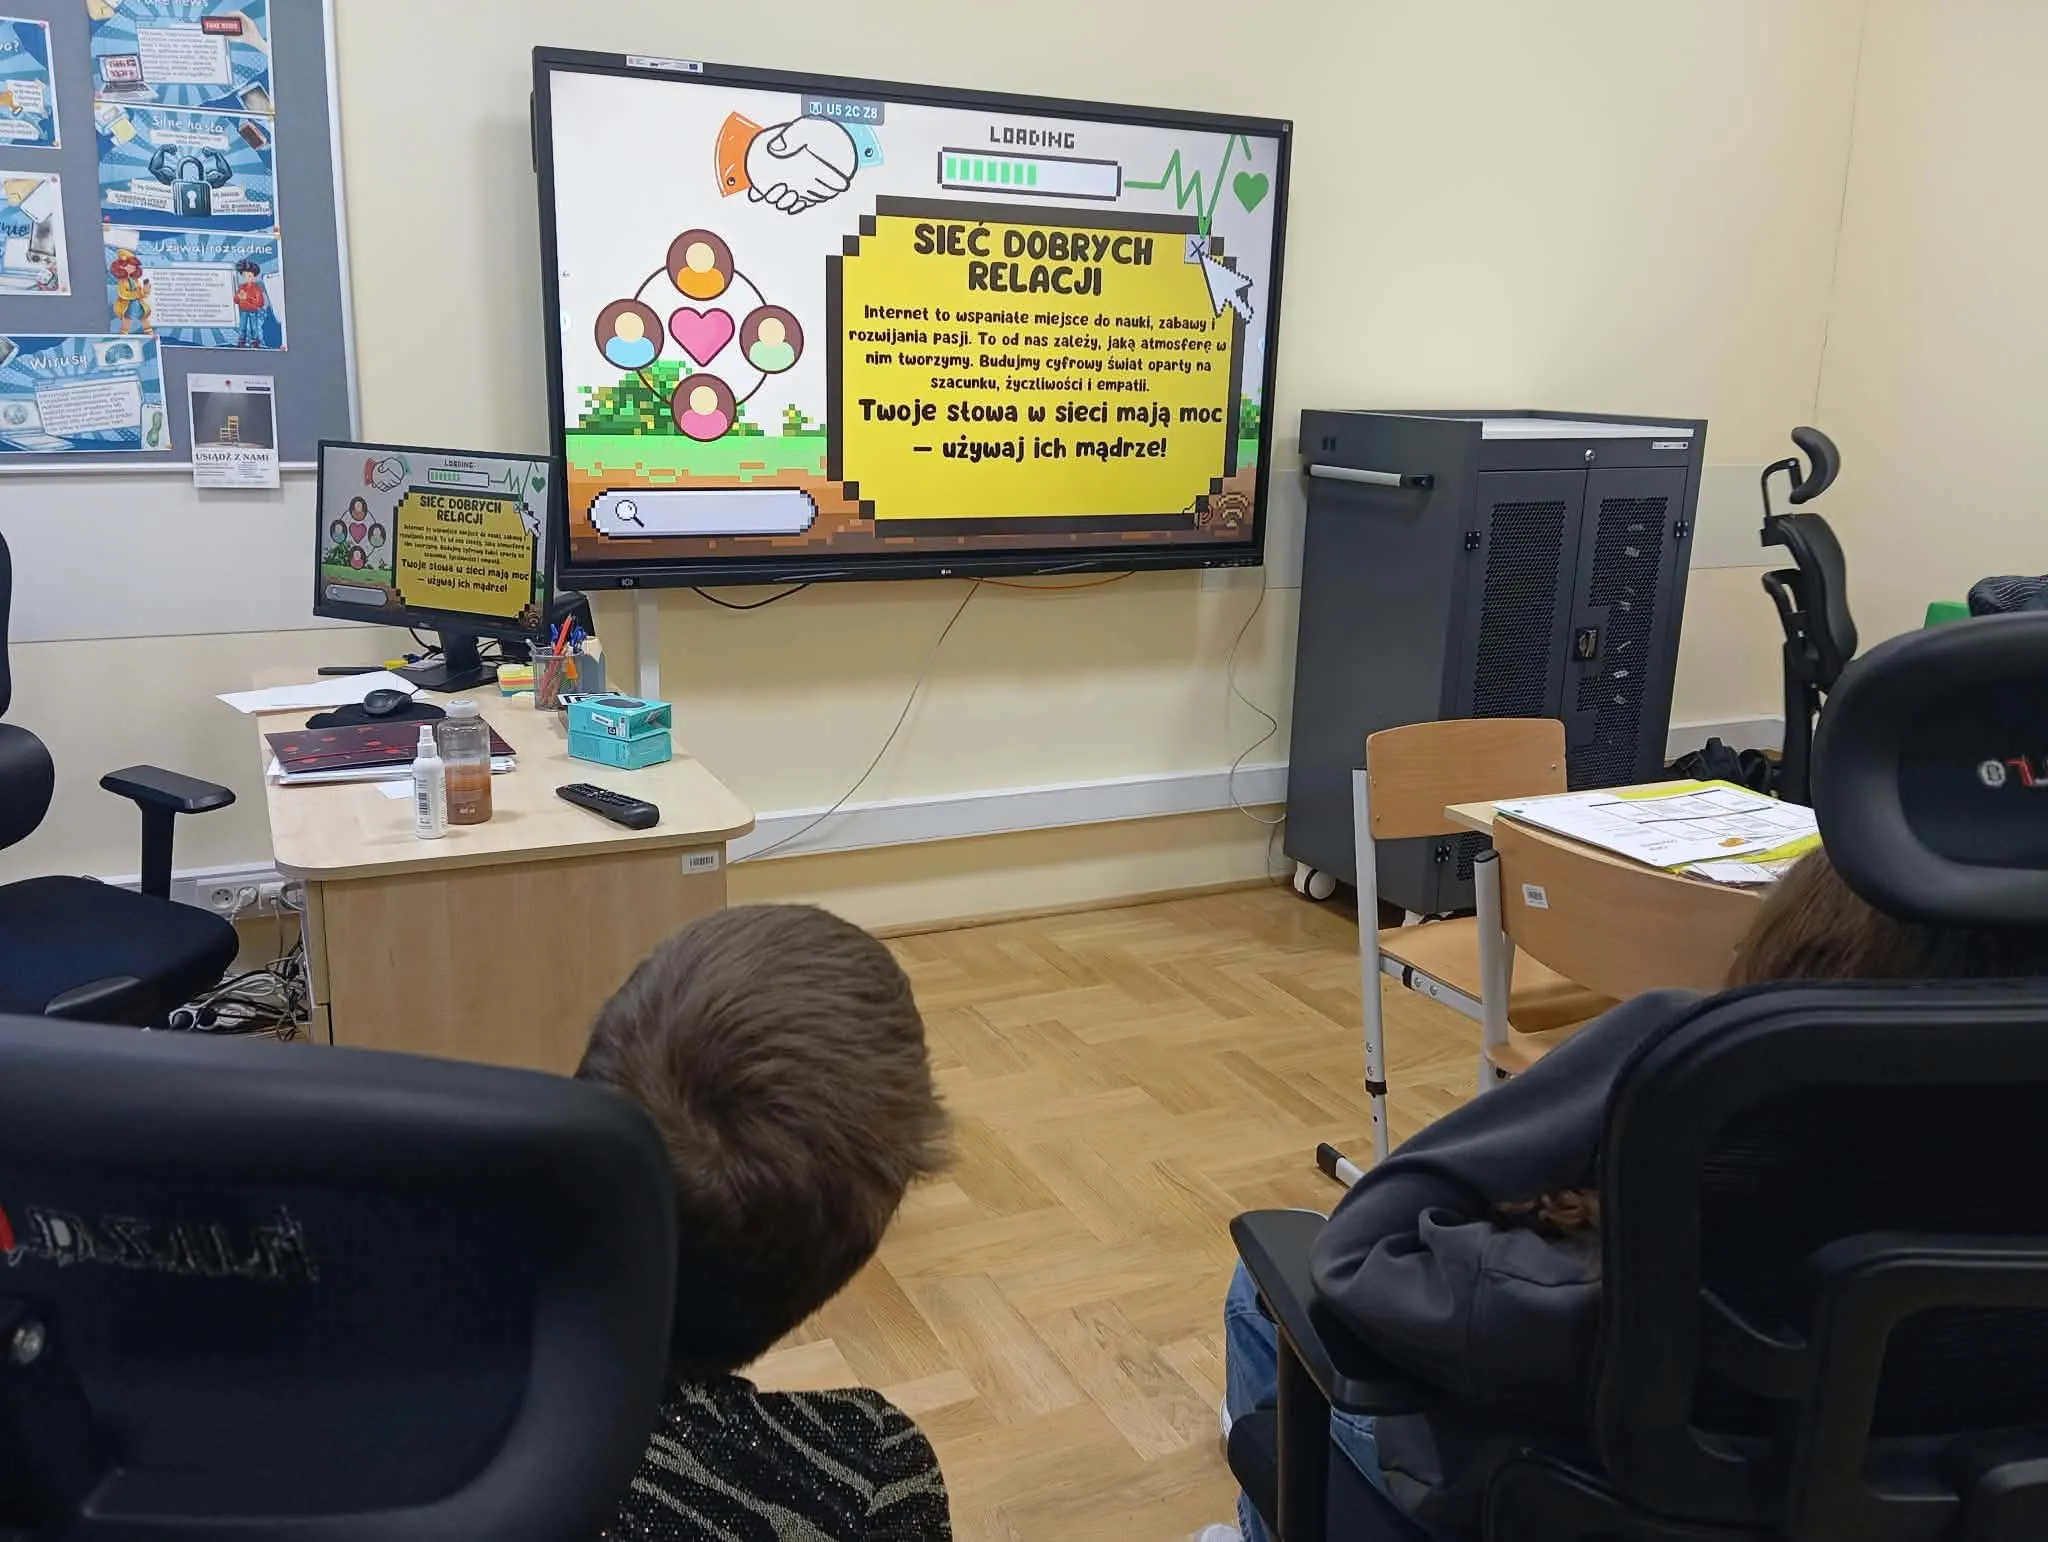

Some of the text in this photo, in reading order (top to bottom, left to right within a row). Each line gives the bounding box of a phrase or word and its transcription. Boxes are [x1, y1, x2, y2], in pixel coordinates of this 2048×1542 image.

[827, 103, 878, 119] U5 2C Z8
[990, 125, 1075, 150] LOADING
[913, 217, 1155, 267] SIEĆ DOBRYCH
[967, 260, 1103, 296] RELACJI
[864, 304, 1216, 333] Internet to wspaniałe miejsce do nauki, zabawy i
[848, 327, 1227, 354] rozwijania pasji. To od nas zależy, jaką atmosferę w
[30, 355, 88, 370] Wirusy
[865, 350, 1212, 375] nim tworzymy. Budujmy cyfrowy świat oparty na
[930, 374, 1150, 393] szacunku, życzliwości i empatii.
[858, 398, 1223, 429] Twoje słowa w sieci mają moc
[942, 433, 1025, 464] używaj
[1033, 436, 1067, 459] ich
[1075, 436, 1167, 463] mądrze!
[436, 509, 483, 525] RELACJI
